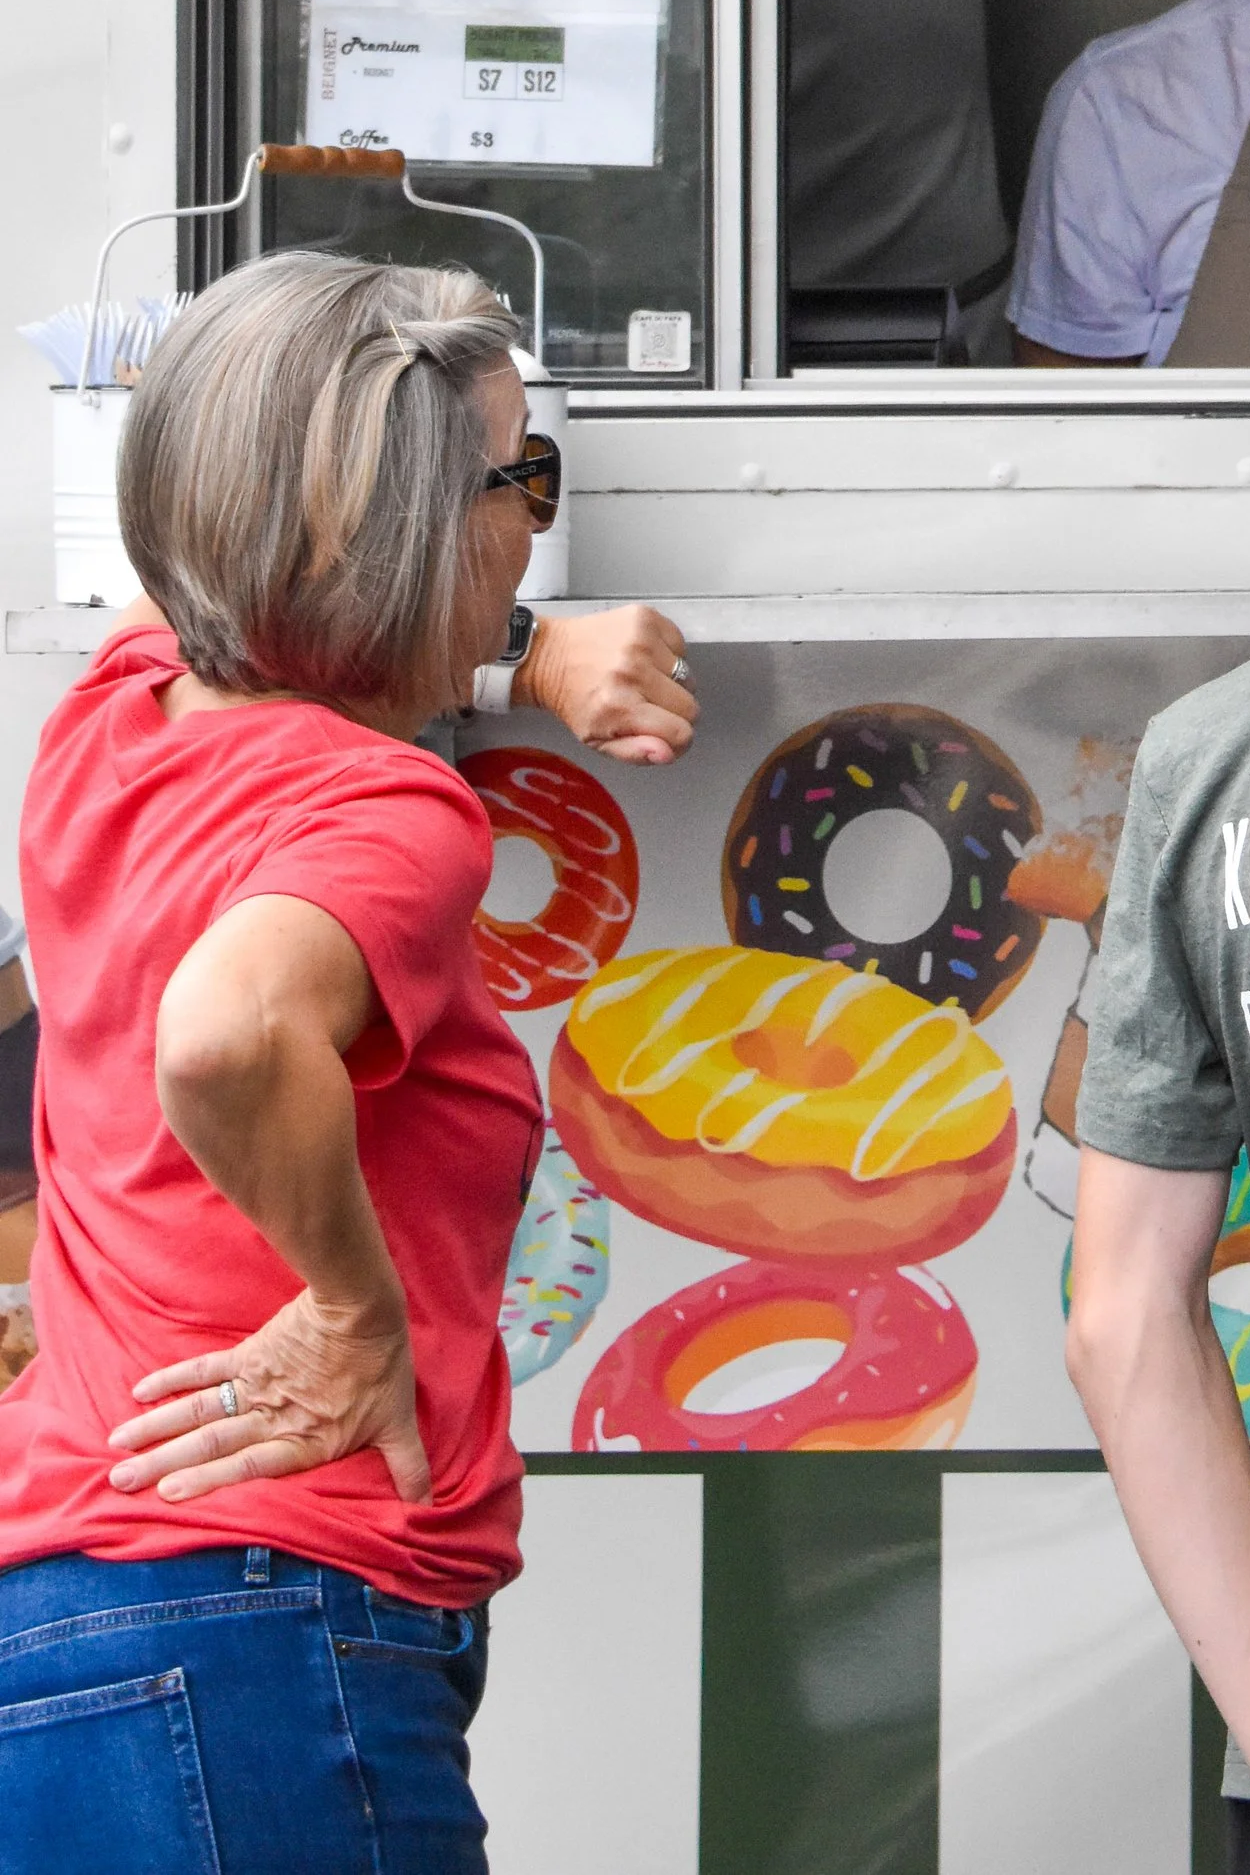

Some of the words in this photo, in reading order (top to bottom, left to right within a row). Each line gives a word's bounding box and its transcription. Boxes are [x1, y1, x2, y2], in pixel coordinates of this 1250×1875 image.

[341, 36, 421, 55] Premium
[478, 68, 502, 92] $7
[524, 69, 556, 93] $12
[339, 129, 390, 148] Coffee
[471, 131, 494, 147] $3
